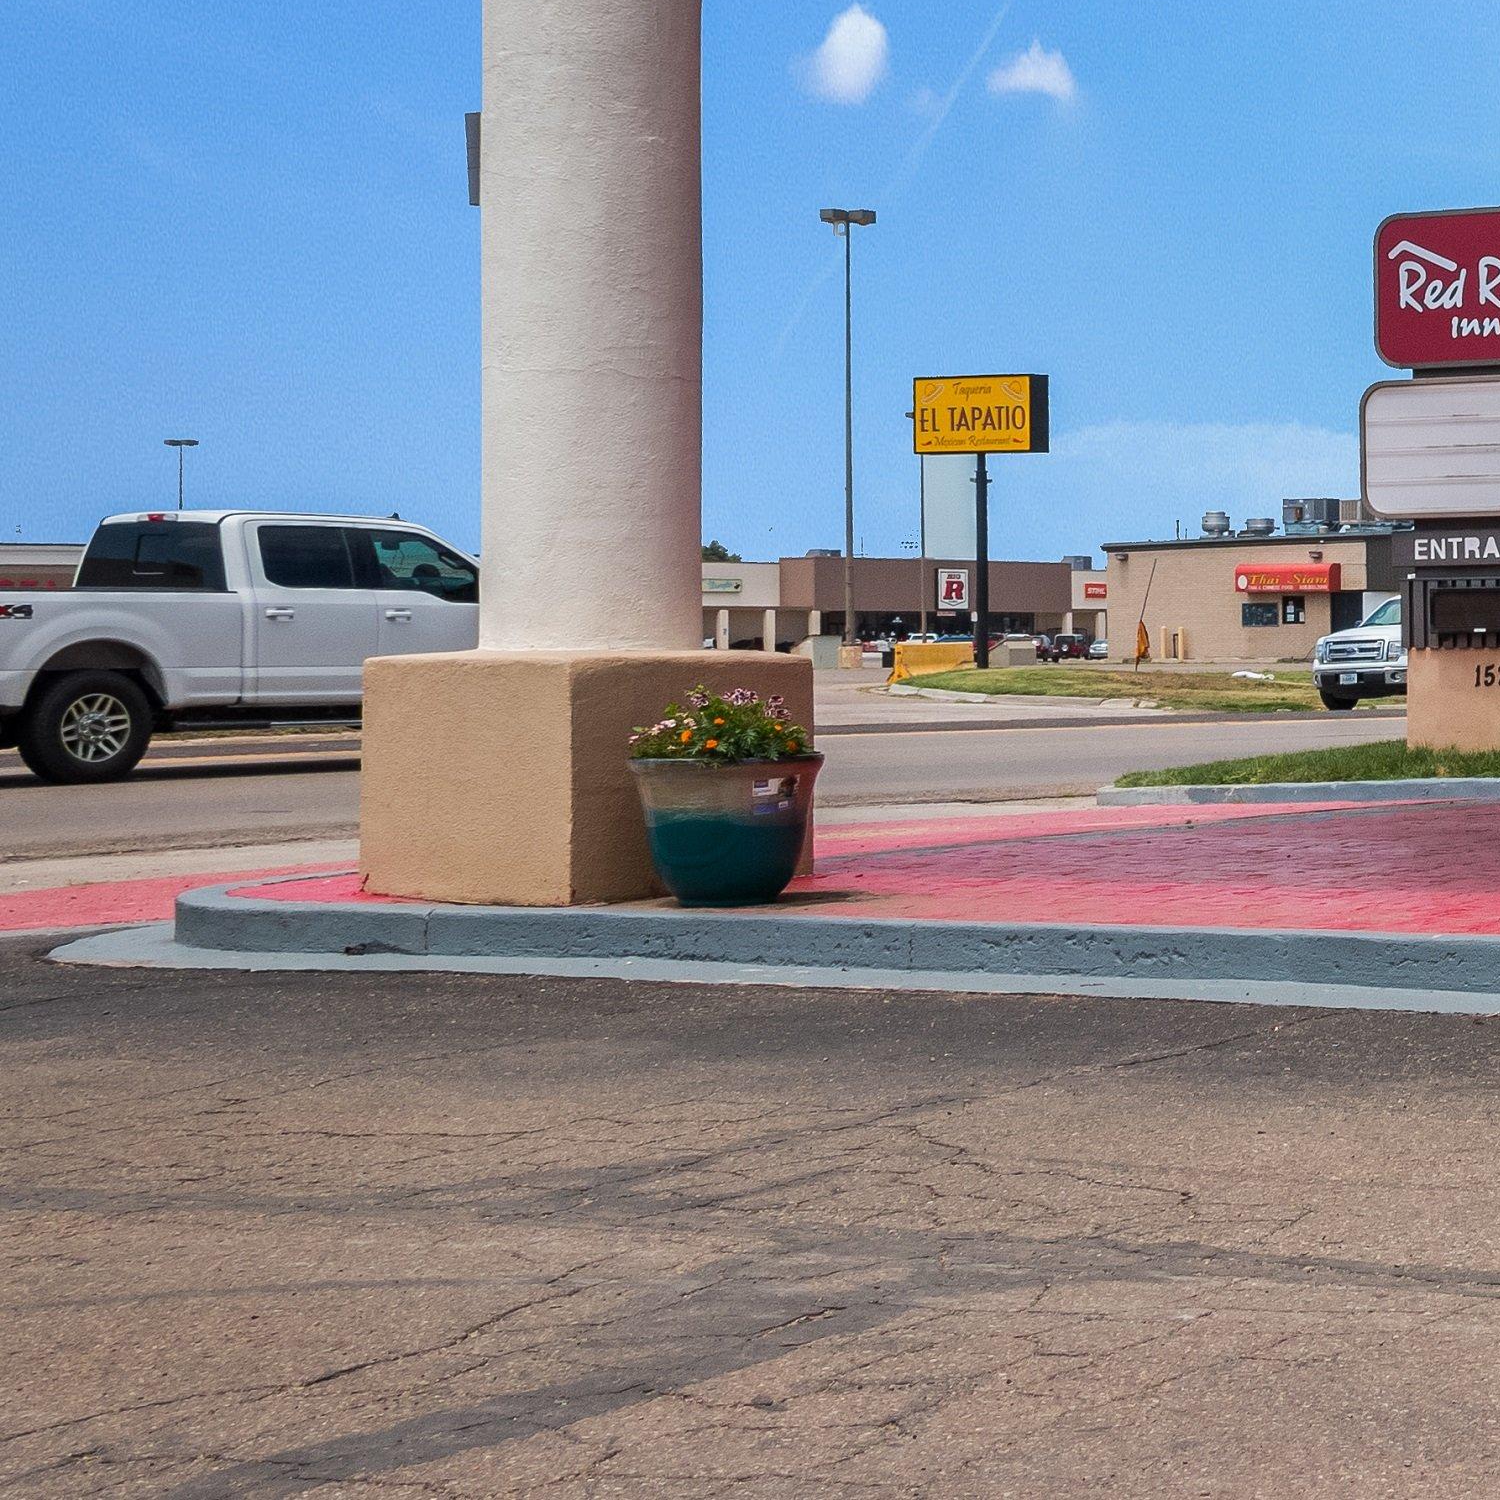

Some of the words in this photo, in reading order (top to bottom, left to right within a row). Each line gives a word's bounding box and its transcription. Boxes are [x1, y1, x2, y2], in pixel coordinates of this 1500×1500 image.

[1400, 260, 1467, 313] Red
[953, 382, 992, 401] Taqueria
[920, 407, 940, 432] EL
[948, 405, 1026, 431] TAPATIO
[1249, 573, 1280, 585] Thai
[1287, 573, 1328, 585] Siam
[943, 580, 964, 600] R
[0, 604, 34, 619] X4
